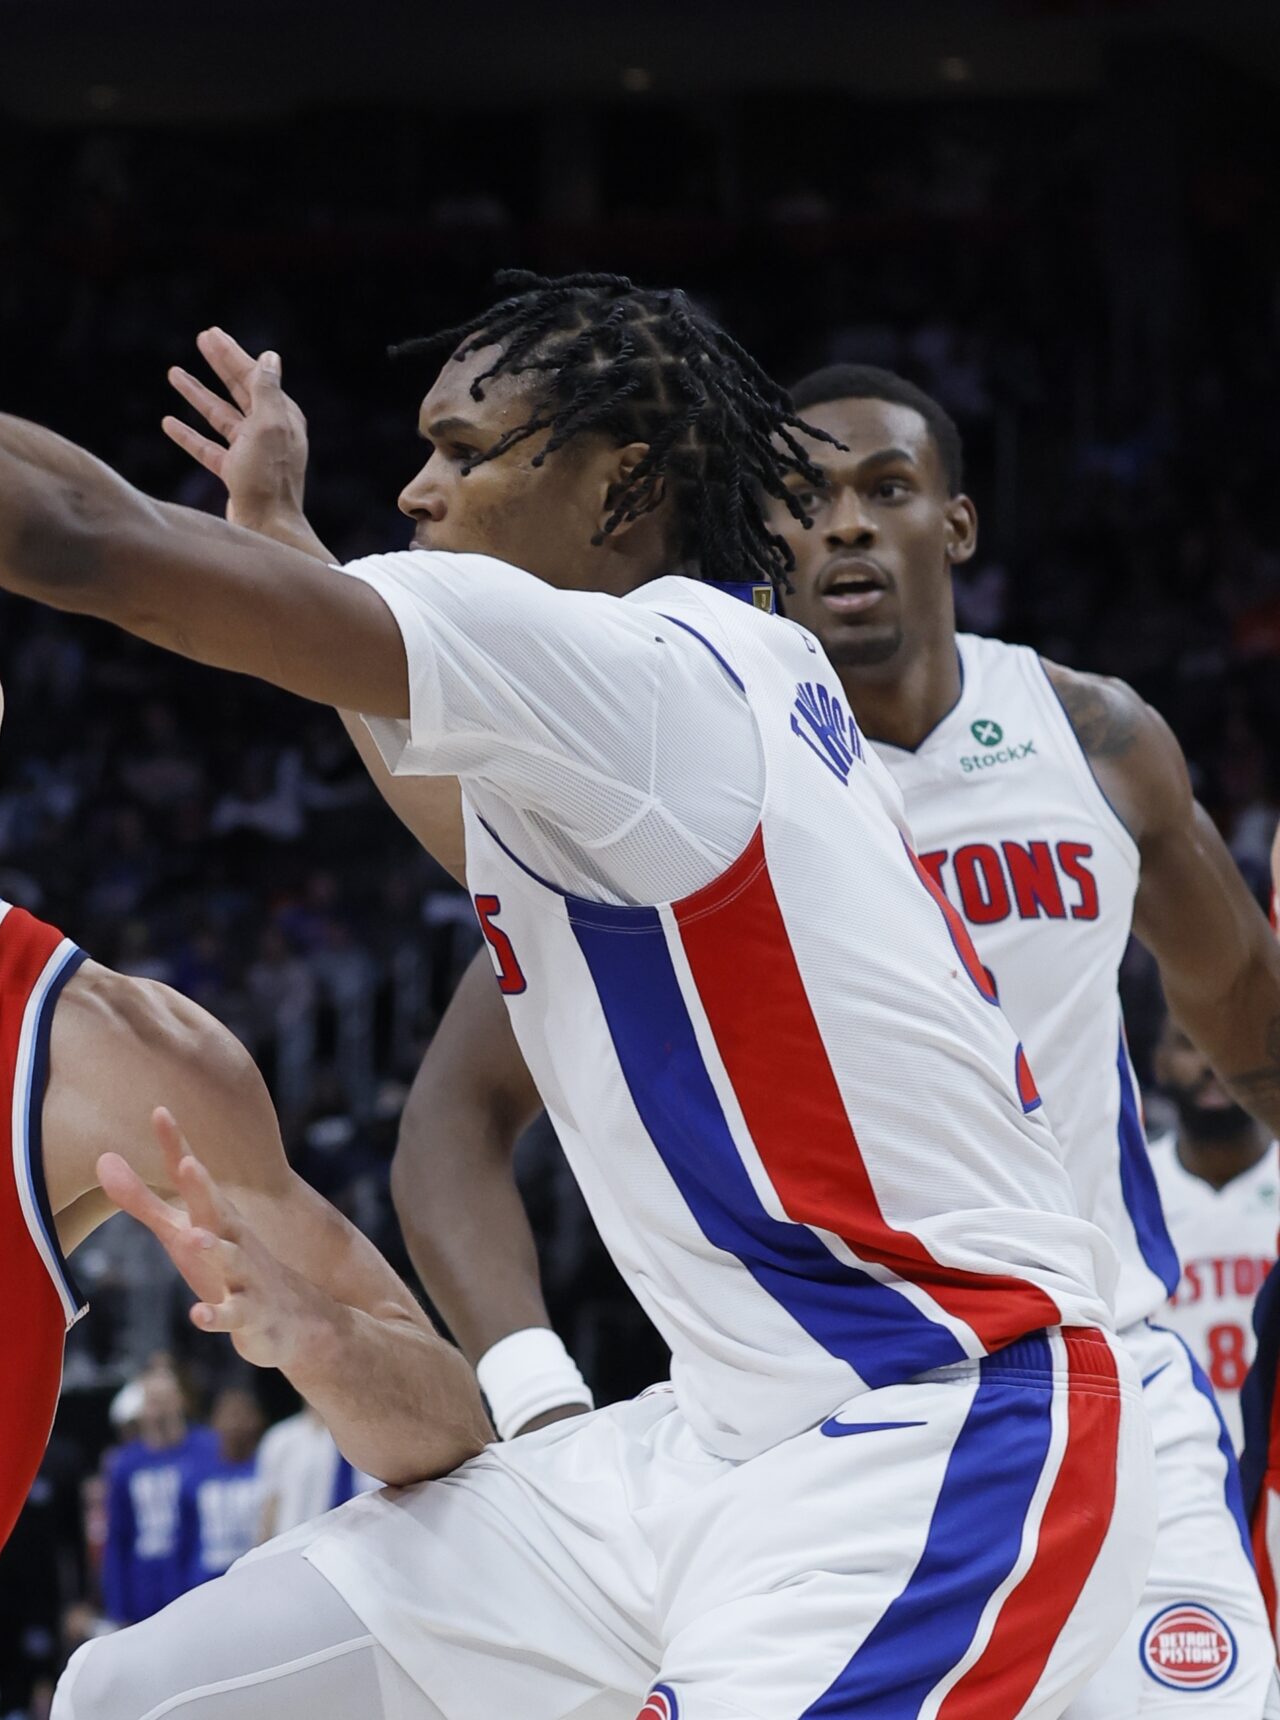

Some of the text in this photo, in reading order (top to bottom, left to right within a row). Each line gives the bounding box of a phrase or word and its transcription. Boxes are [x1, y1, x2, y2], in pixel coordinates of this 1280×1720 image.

[959, 740, 1038, 773] StockX
[1207, 1316, 1248, 1391] 8
[1158, 1630, 1218, 1648] DETROIT
[1159, 1647, 1221, 1665] PISTONS
